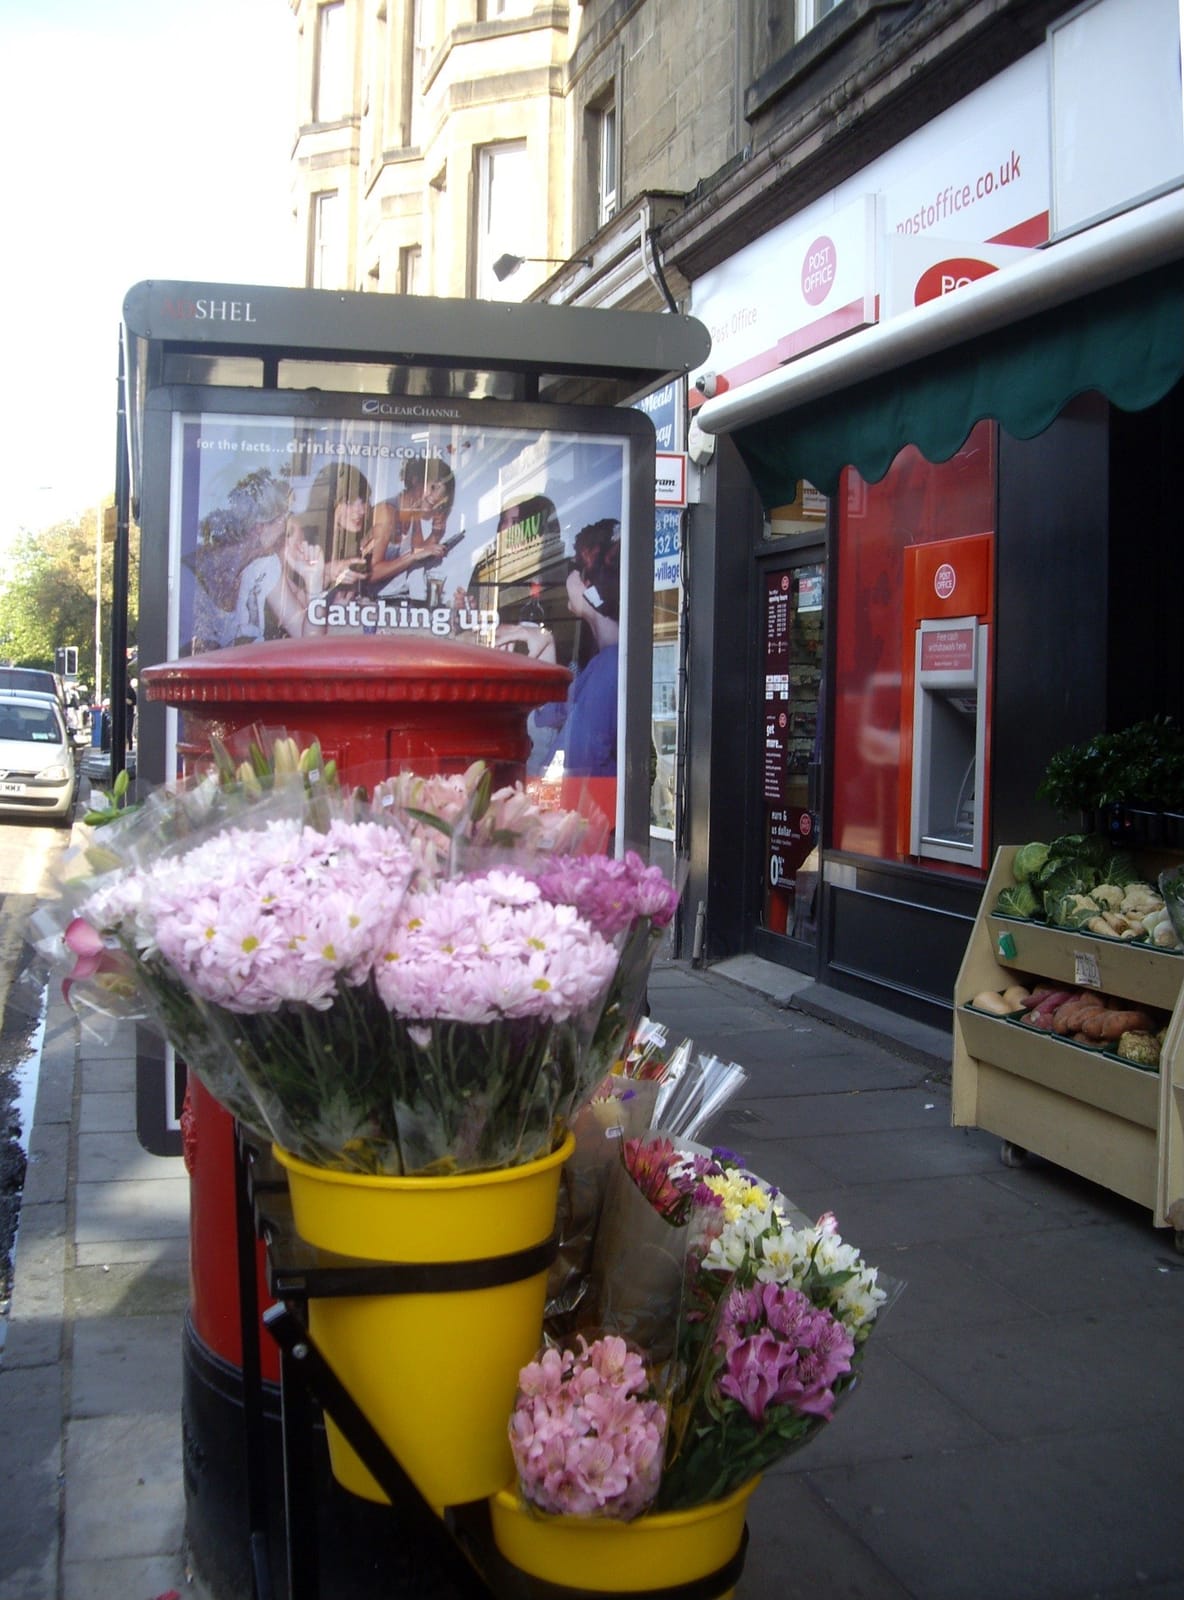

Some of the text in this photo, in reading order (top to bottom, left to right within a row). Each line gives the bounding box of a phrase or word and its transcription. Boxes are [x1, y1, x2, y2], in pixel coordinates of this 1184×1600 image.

[808, 246, 831, 272] POST
[803, 264, 833, 293] OFFICE
[196, 438, 214, 449] for
[217, 440, 238, 451] the
[307, 599, 499, 635] Catching up
